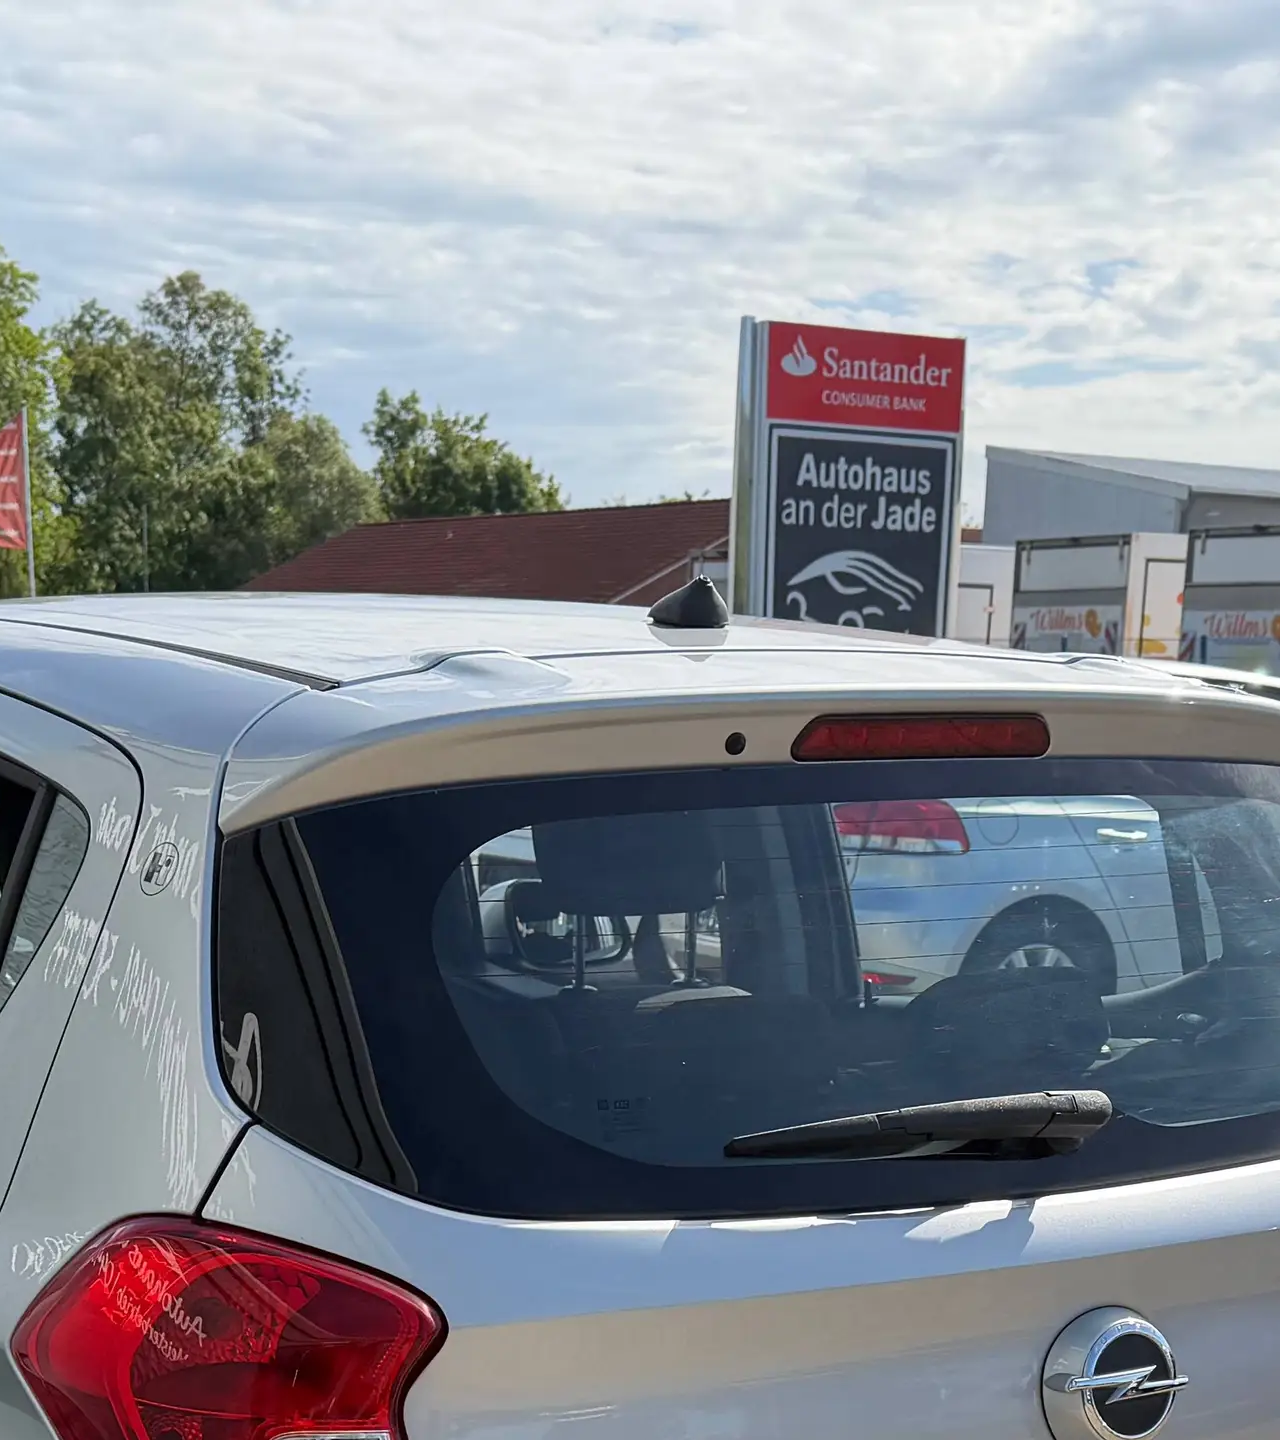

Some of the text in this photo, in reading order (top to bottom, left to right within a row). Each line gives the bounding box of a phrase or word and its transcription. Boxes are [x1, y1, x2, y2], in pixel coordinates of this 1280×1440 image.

[822, 347, 952, 387] Santander
[822, 390, 927, 412] CONSUMER BANK
[796, 453, 932, 495] Autohaus
[781, 493, 937, 533] an der Jade
